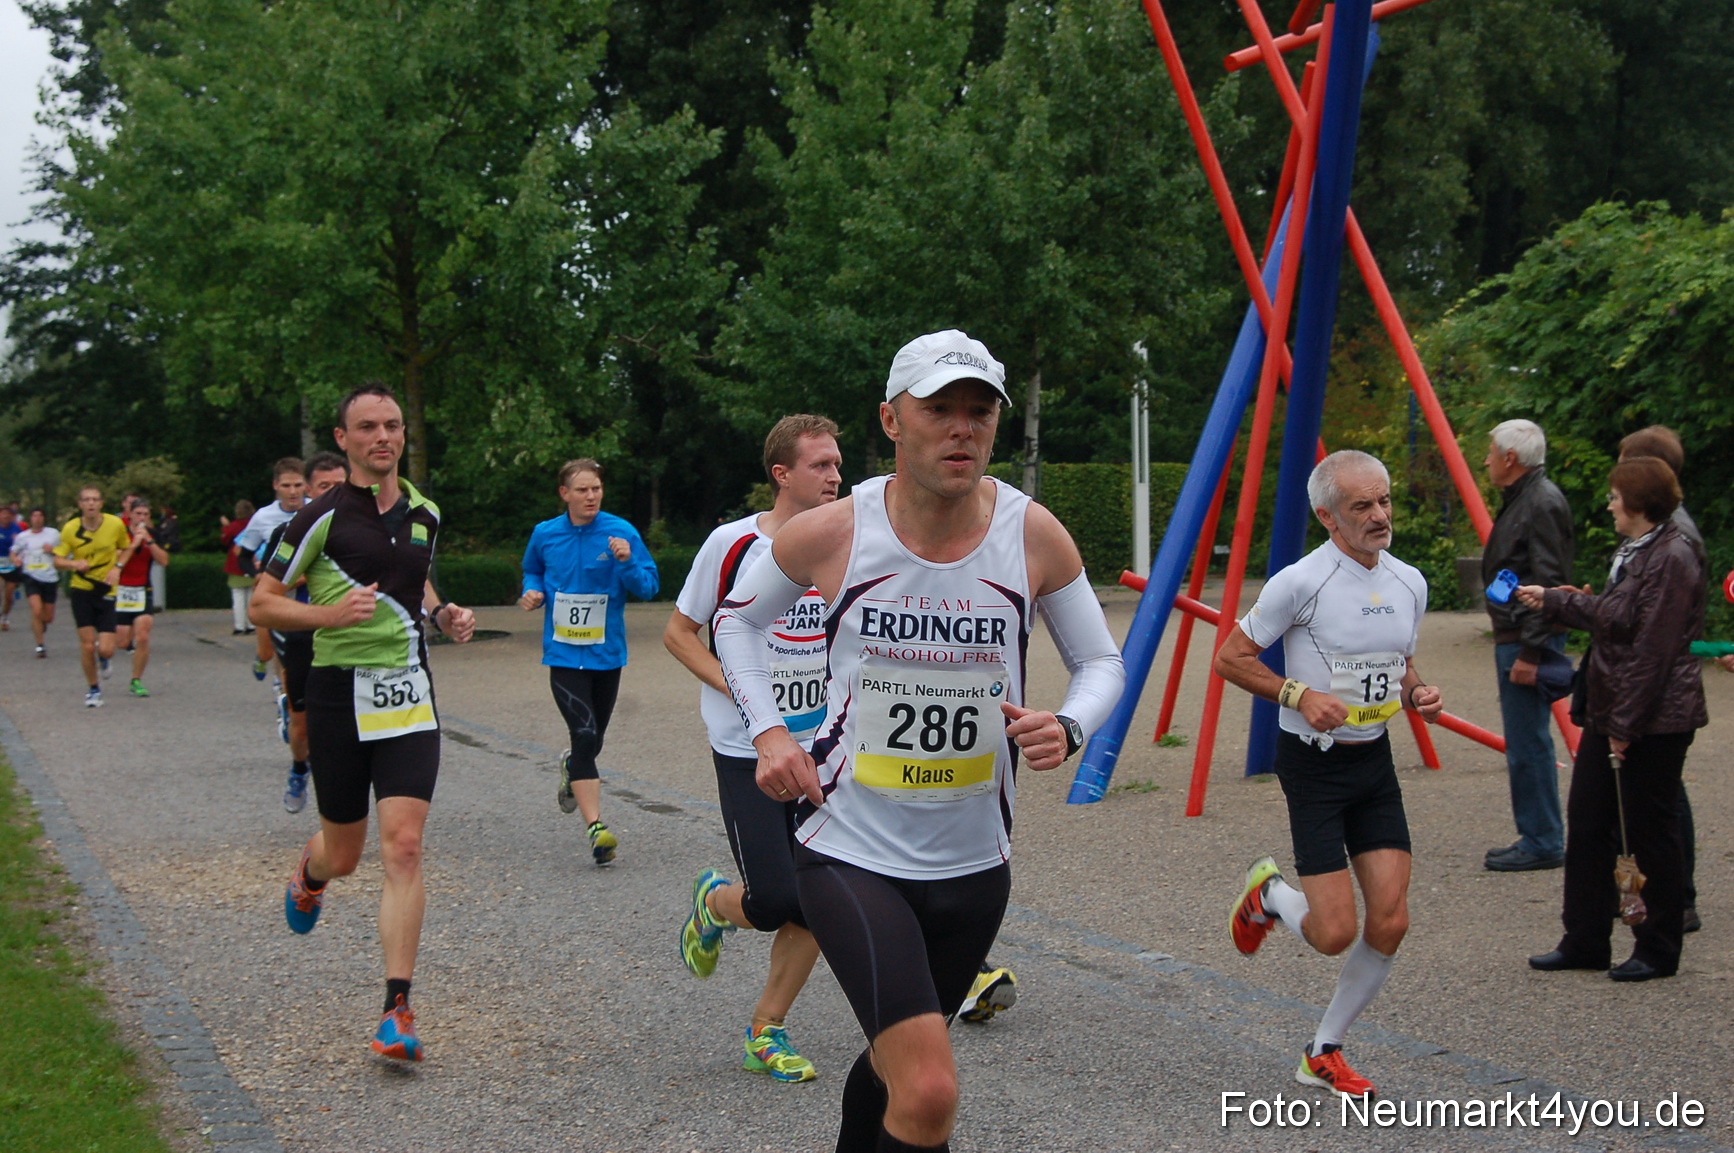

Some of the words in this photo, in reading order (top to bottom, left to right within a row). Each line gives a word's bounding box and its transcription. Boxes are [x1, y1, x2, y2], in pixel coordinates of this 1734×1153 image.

[901, 595, 972, 612] TEAM
[569, 606, 591, 625] 87
[567, 629, 592, 638] Steven
[859, 606, 1007, 647] ERDINGER
[774, 646, 811, 656] sportliche
[1334, 660, 1363, 670] PARTL
[1365, 659, 1399, 670] Neumarkt
[727, 669, 749, 706] TEAM
[861, 678, 911, 696] PARTL
[914, 684, 986, 699] Neumarkt
[1360, 672, 1389, 703] 13
[1358, 708, 1381, 722] Willi
[886, 702, 980, 753] 286
[902, 764, 955, 785] Klaus
